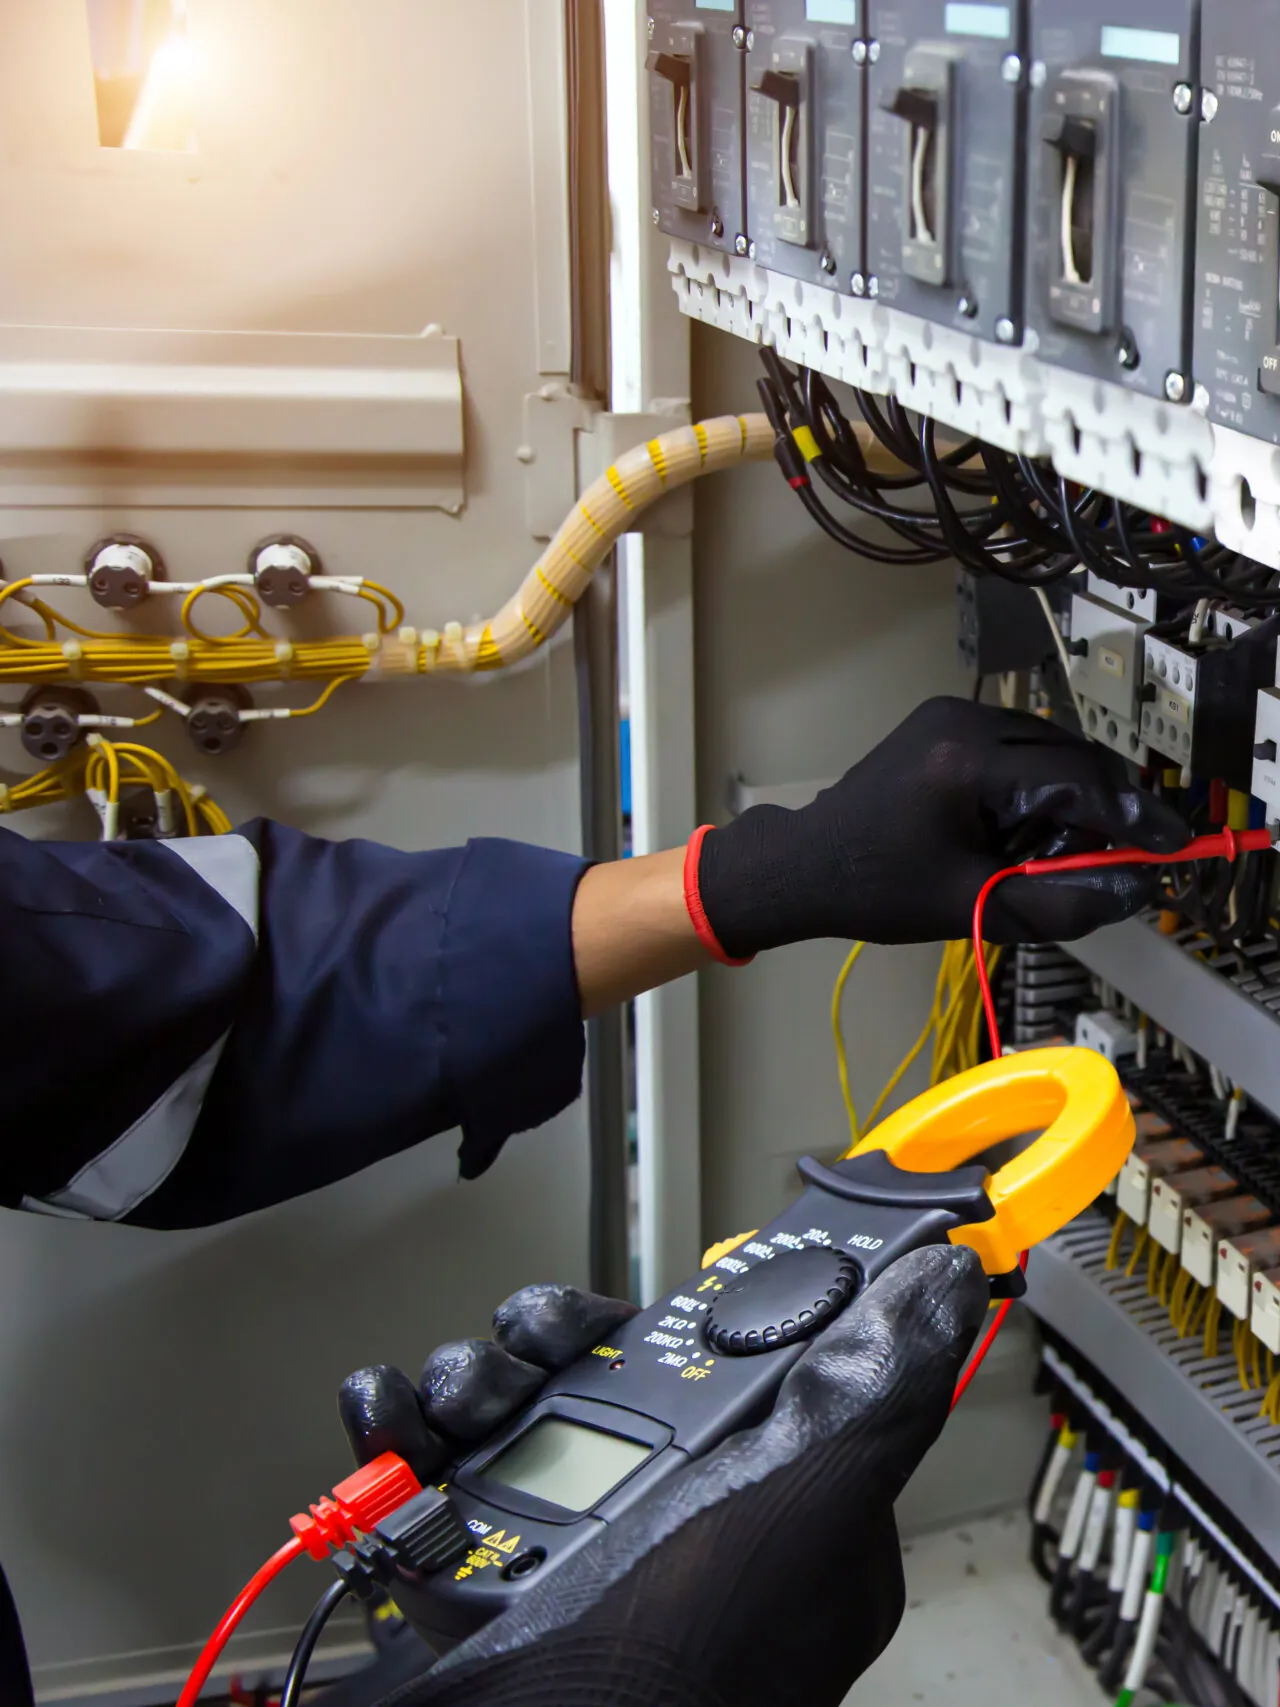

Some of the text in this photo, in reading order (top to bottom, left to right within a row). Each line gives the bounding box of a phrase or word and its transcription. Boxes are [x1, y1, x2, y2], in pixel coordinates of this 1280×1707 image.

[1262, 355, 1278, 371] OFF
[847, 1233, 884, 1251] HOLD
[592, 1345, 624, 1359] LIGHT
[681, 1365, 711, 1381] OFF
[467, 1519, 493, 1535] COM
